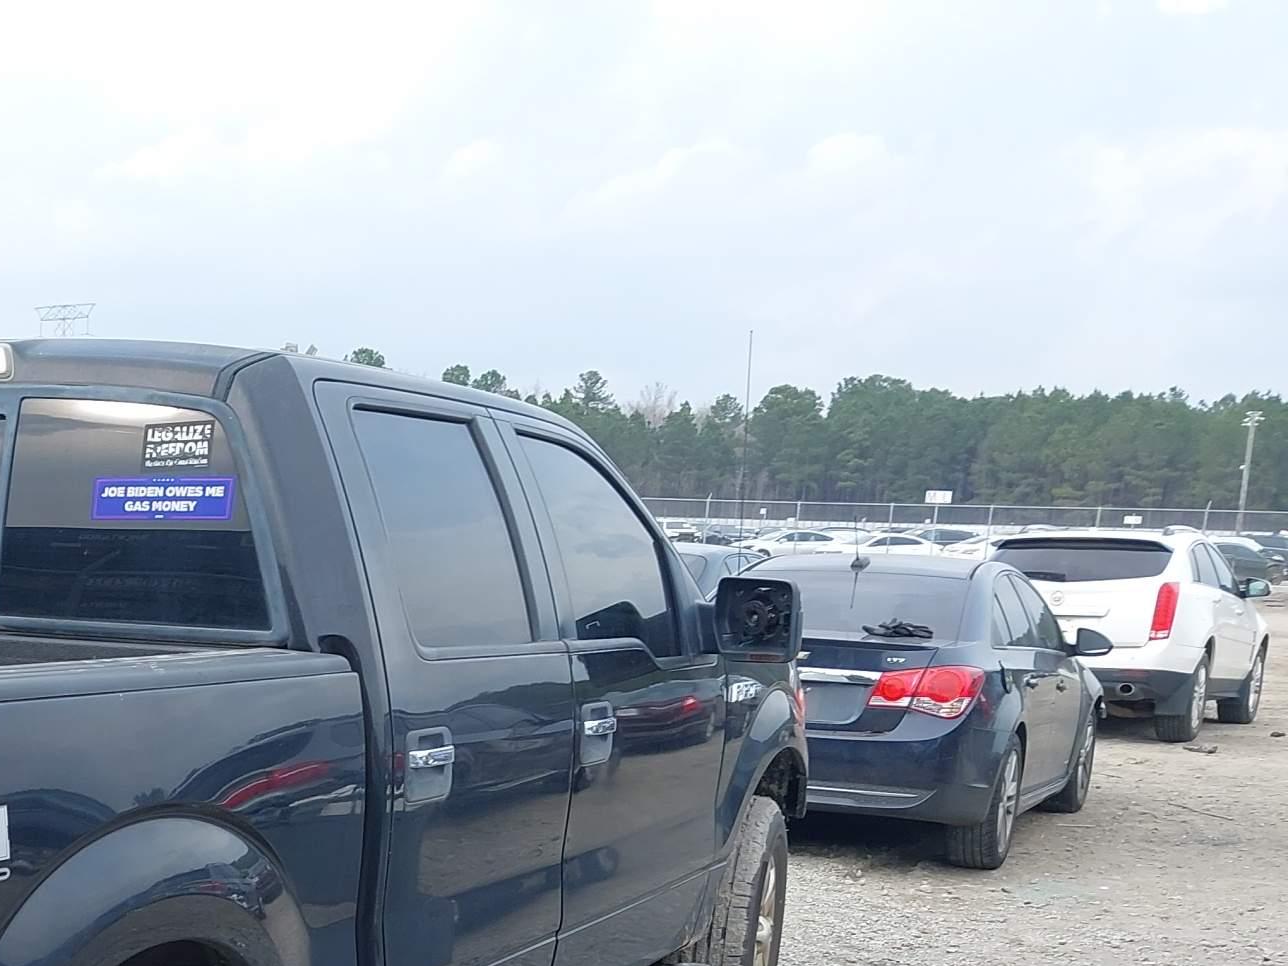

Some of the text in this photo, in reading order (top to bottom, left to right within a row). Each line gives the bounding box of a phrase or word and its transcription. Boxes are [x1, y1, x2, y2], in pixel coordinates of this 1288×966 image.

[101, 486, 225, 497] JOE BIDEN OWES ME
[124, 501, 197, 512] GAS MONEY
